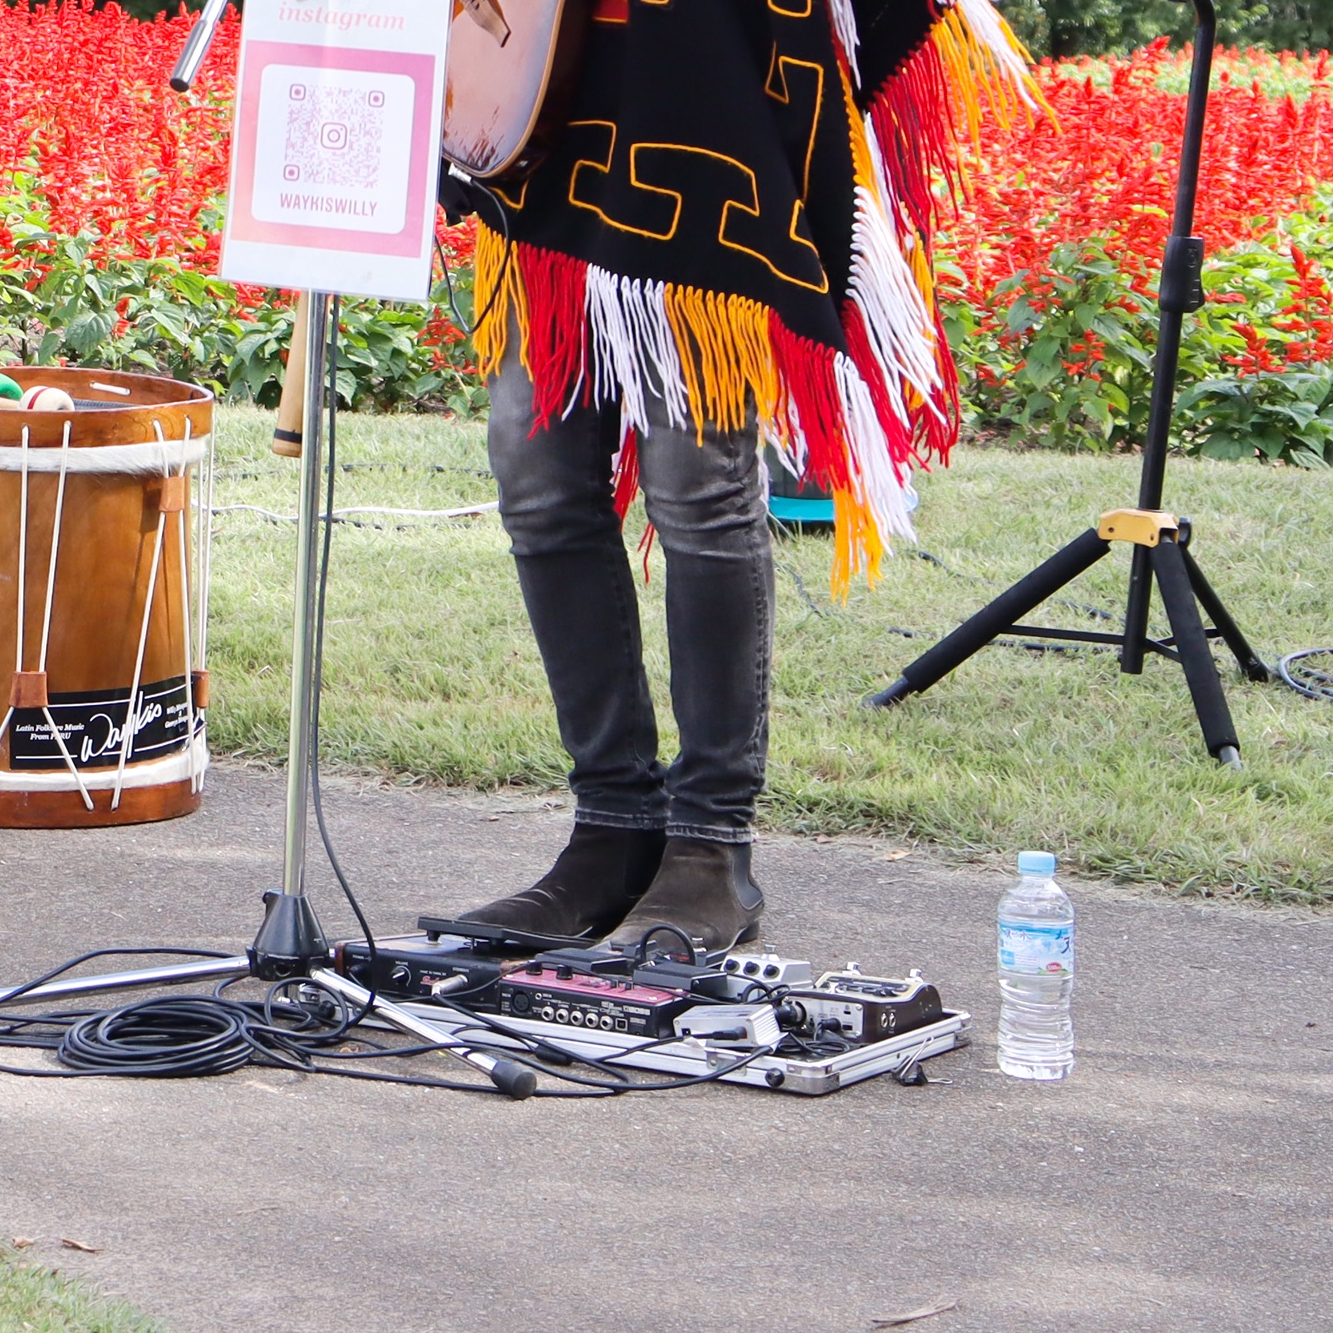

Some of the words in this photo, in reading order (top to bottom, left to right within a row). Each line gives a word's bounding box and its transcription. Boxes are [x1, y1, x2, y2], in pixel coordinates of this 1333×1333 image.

[278, 1, 405, 31] instagram
[280, 193, 377, 216] WAYKISWILLY
[15, 724, 35, 732] Latin
[64, 722, 85, 732] Music
[30, 733, 50, 741] From
[50, 732, 72, 741] PRU
